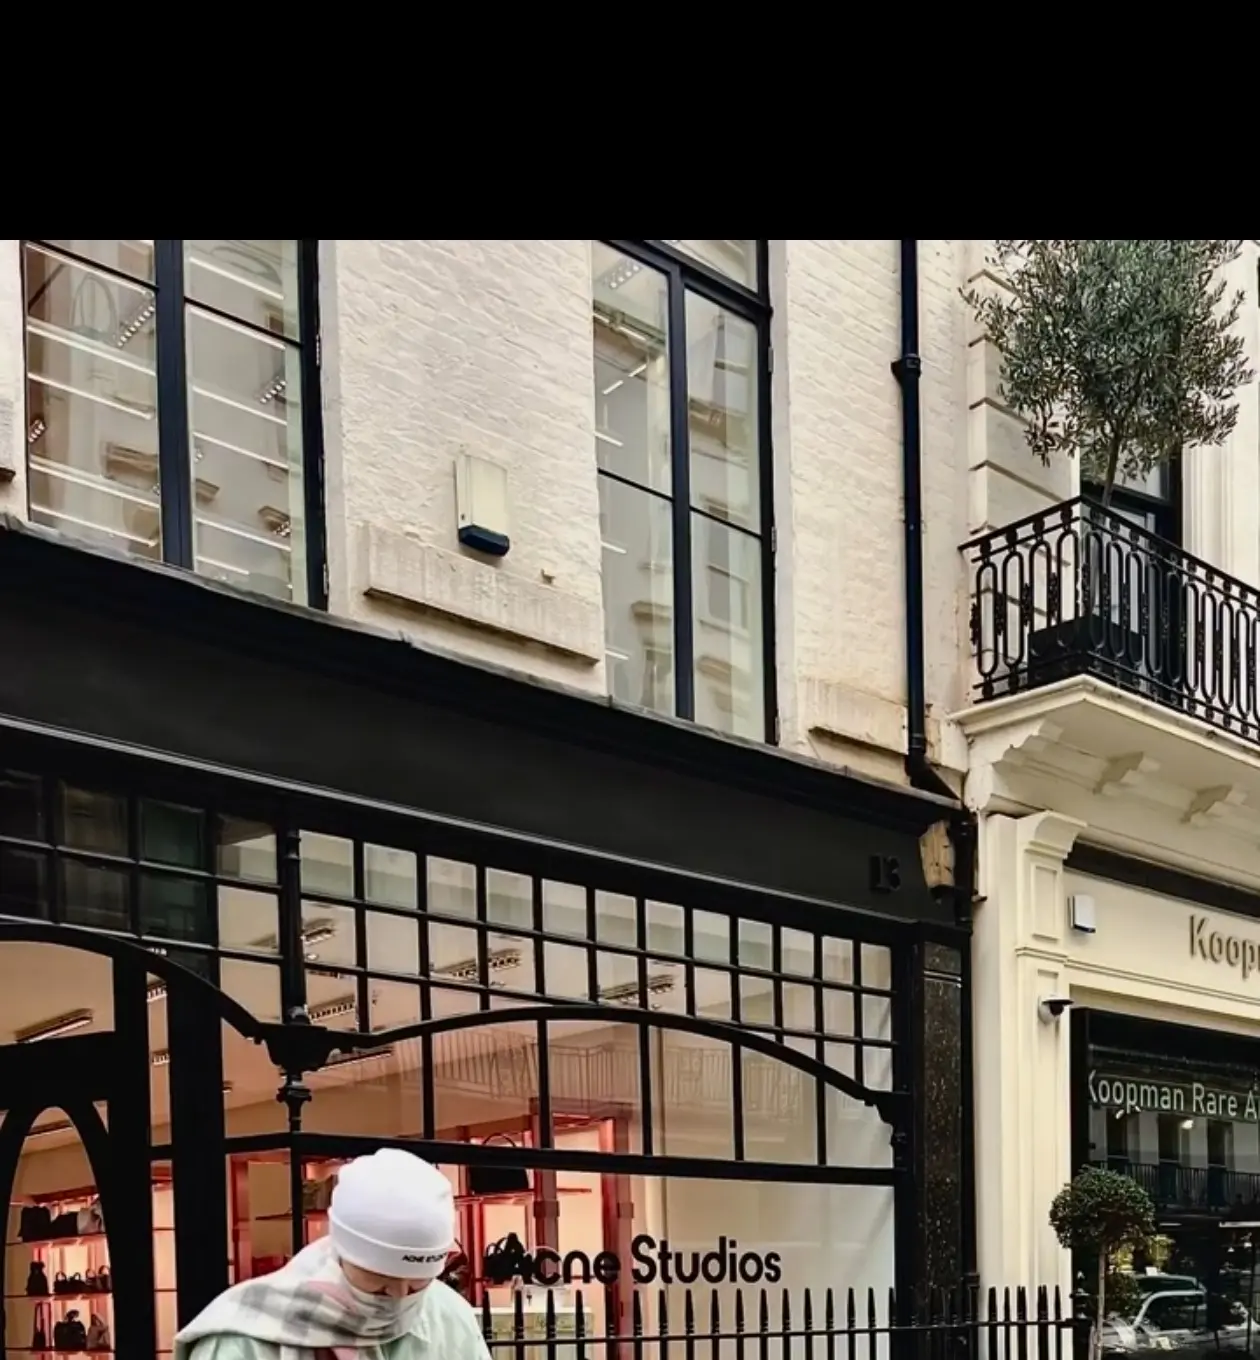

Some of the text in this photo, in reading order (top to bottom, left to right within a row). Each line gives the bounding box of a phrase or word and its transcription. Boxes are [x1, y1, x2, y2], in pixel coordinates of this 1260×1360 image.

[1189, 914, 1260, 979] Koop
[1193, 1082, 1238, 1117] Rare
[631, 1234, 781, 1284] Studios
